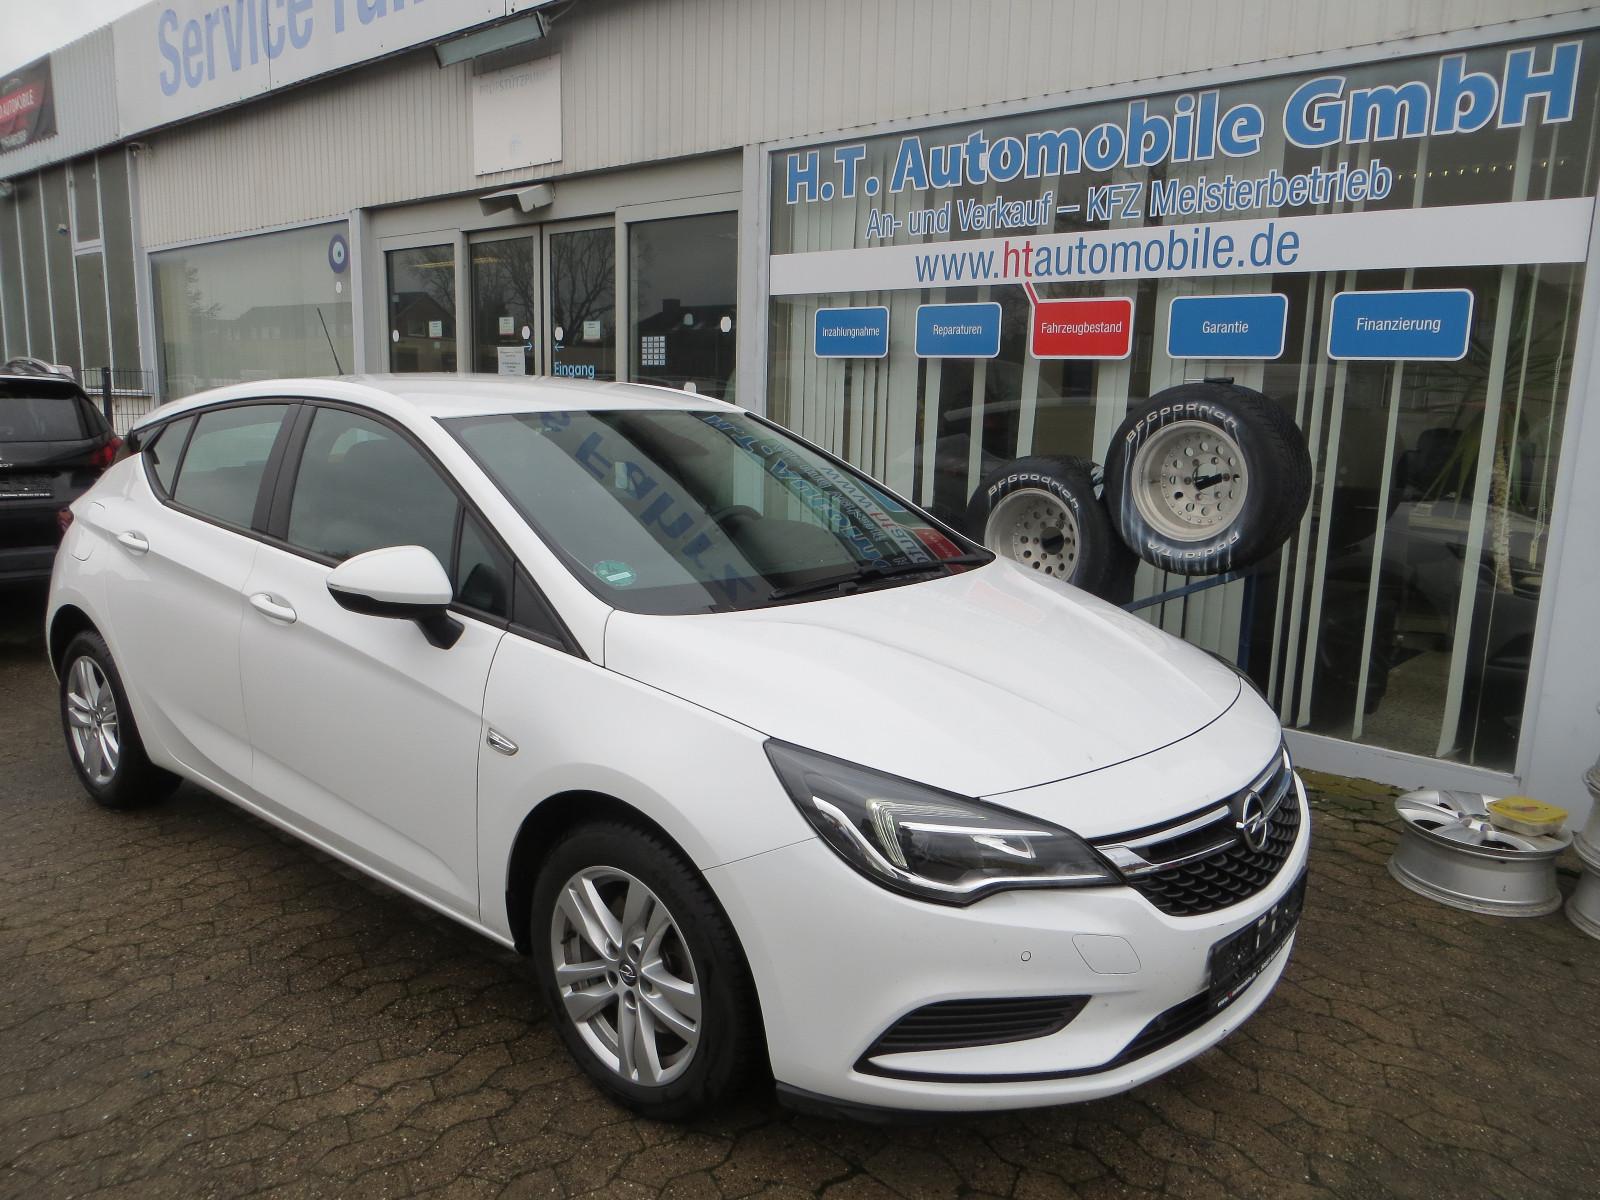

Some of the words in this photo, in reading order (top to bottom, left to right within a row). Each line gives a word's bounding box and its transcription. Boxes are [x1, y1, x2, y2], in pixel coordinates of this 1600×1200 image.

[786, 143, 880, 204] H.T.
[890, 89, 1265, 193] Automobile
[1283, 39, 1583, 148] GmbH
[866, 208, 902, 239] An-
[908, 201, 951, 236] und
[957, 191, 1053, 231] Verkauf
[1087, 182, 1143, 222] KFZ
[1150, 159, 1393, 217] Meisterbetrieb
[916, 223, 1301, 283] www.htautomobile.de
[821, 326, 880, 339] Inzahlungnahme
[933, 323, 982, 336] Reparaturen
[1041, 320, 1122, 337] Fahrzeugbestand
[1202, 320, 1249, 335] Garantie
[1356, 317, 1441, 334] Finanzierung
[554, 361, 595, 379] Eingang
[1126, 402, 1237, 442] BFGoodrich
[988, 474, 1079, 509] BFGoodrich
